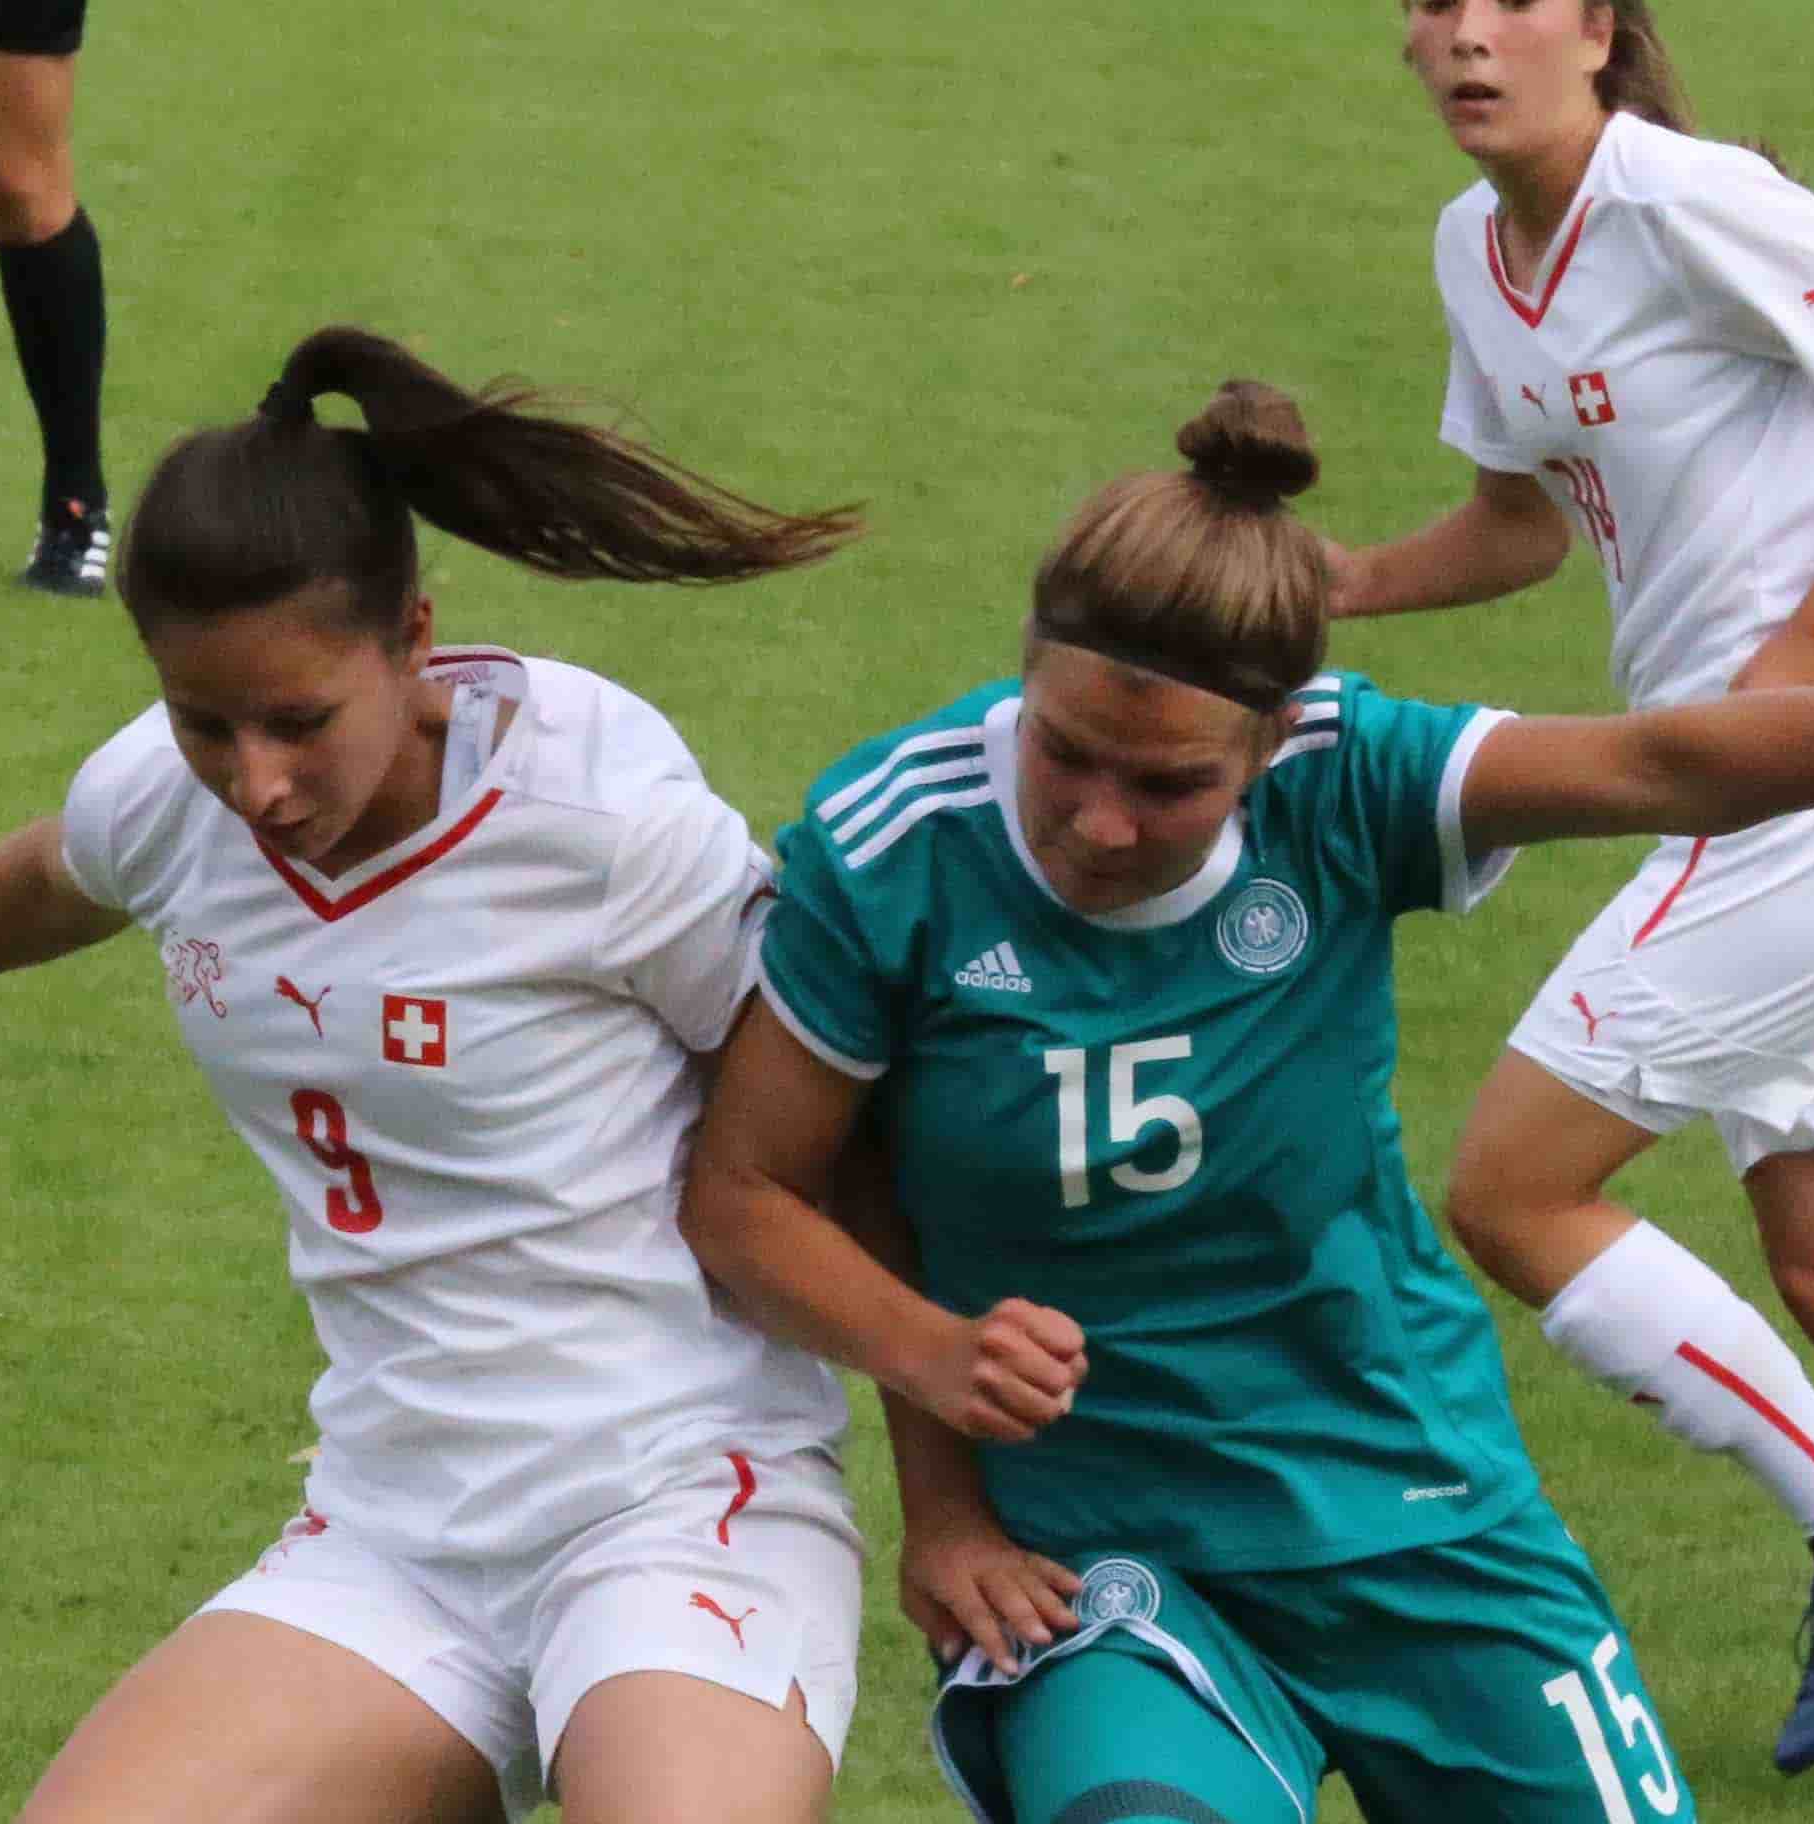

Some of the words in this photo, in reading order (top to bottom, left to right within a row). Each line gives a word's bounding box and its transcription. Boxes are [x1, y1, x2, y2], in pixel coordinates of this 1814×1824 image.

[954, 969, 1032, 993] adidas
[290, 1088, 383, 1233] 9
[1044, 1034, 1203, 1208] 15
